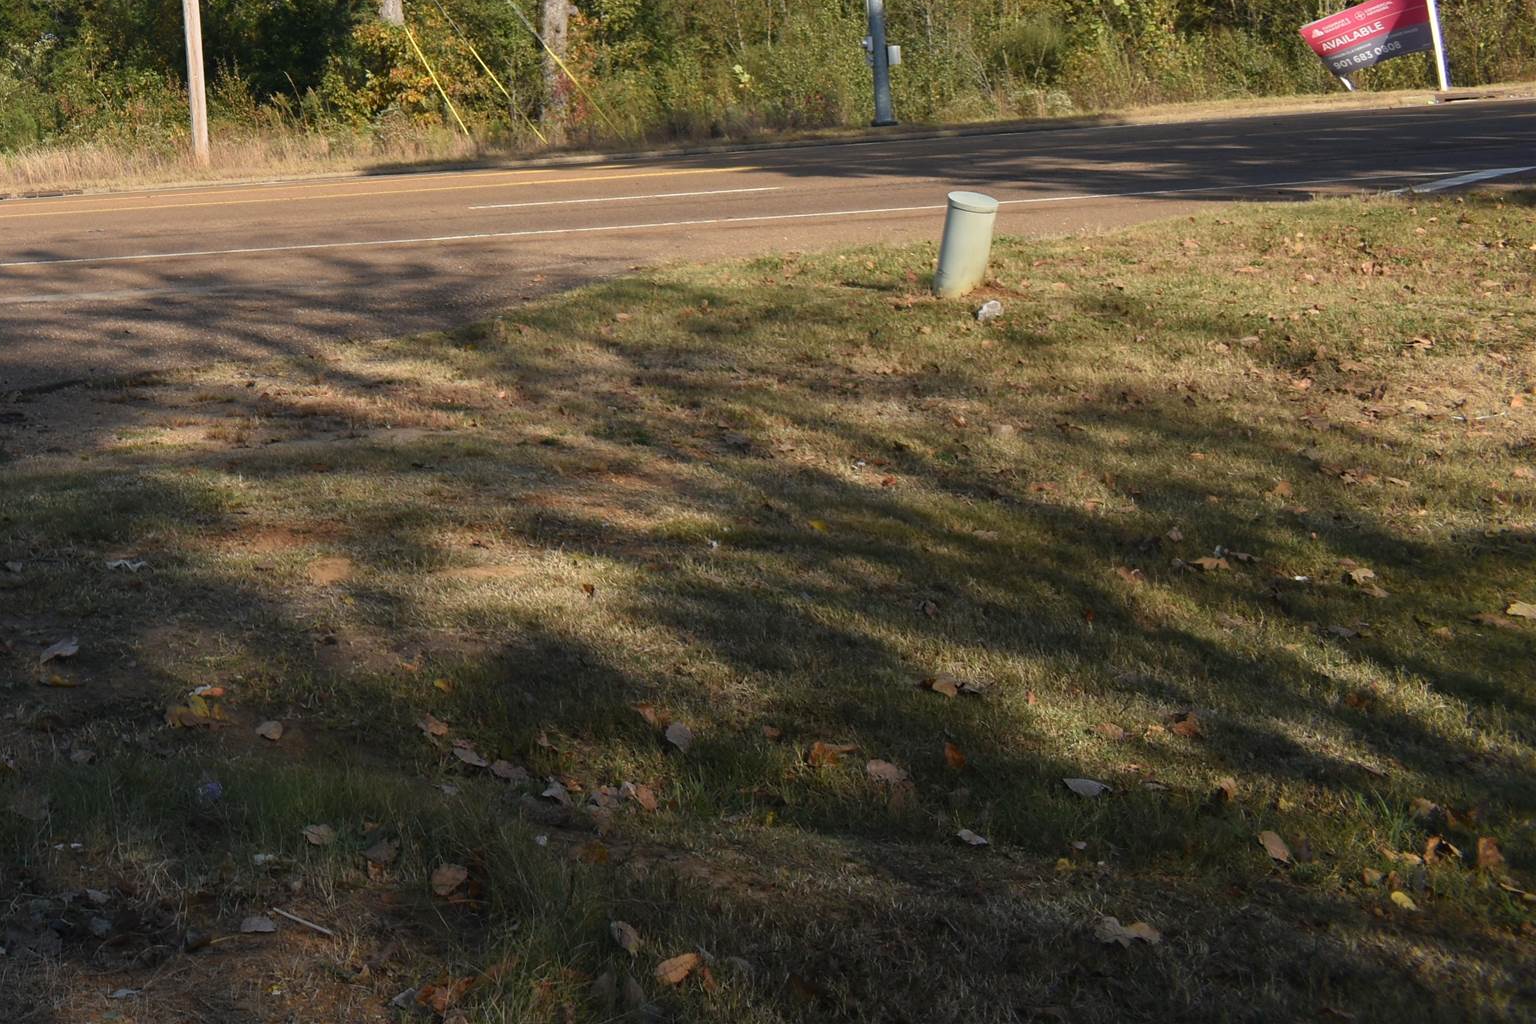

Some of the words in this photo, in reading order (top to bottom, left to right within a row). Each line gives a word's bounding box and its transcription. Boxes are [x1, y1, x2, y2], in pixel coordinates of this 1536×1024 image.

[1321, 21, 1384, 51] AVAILABLE
[1333, 58, 1352, 70] 901
[1352, 50, 1373, 64] 683
